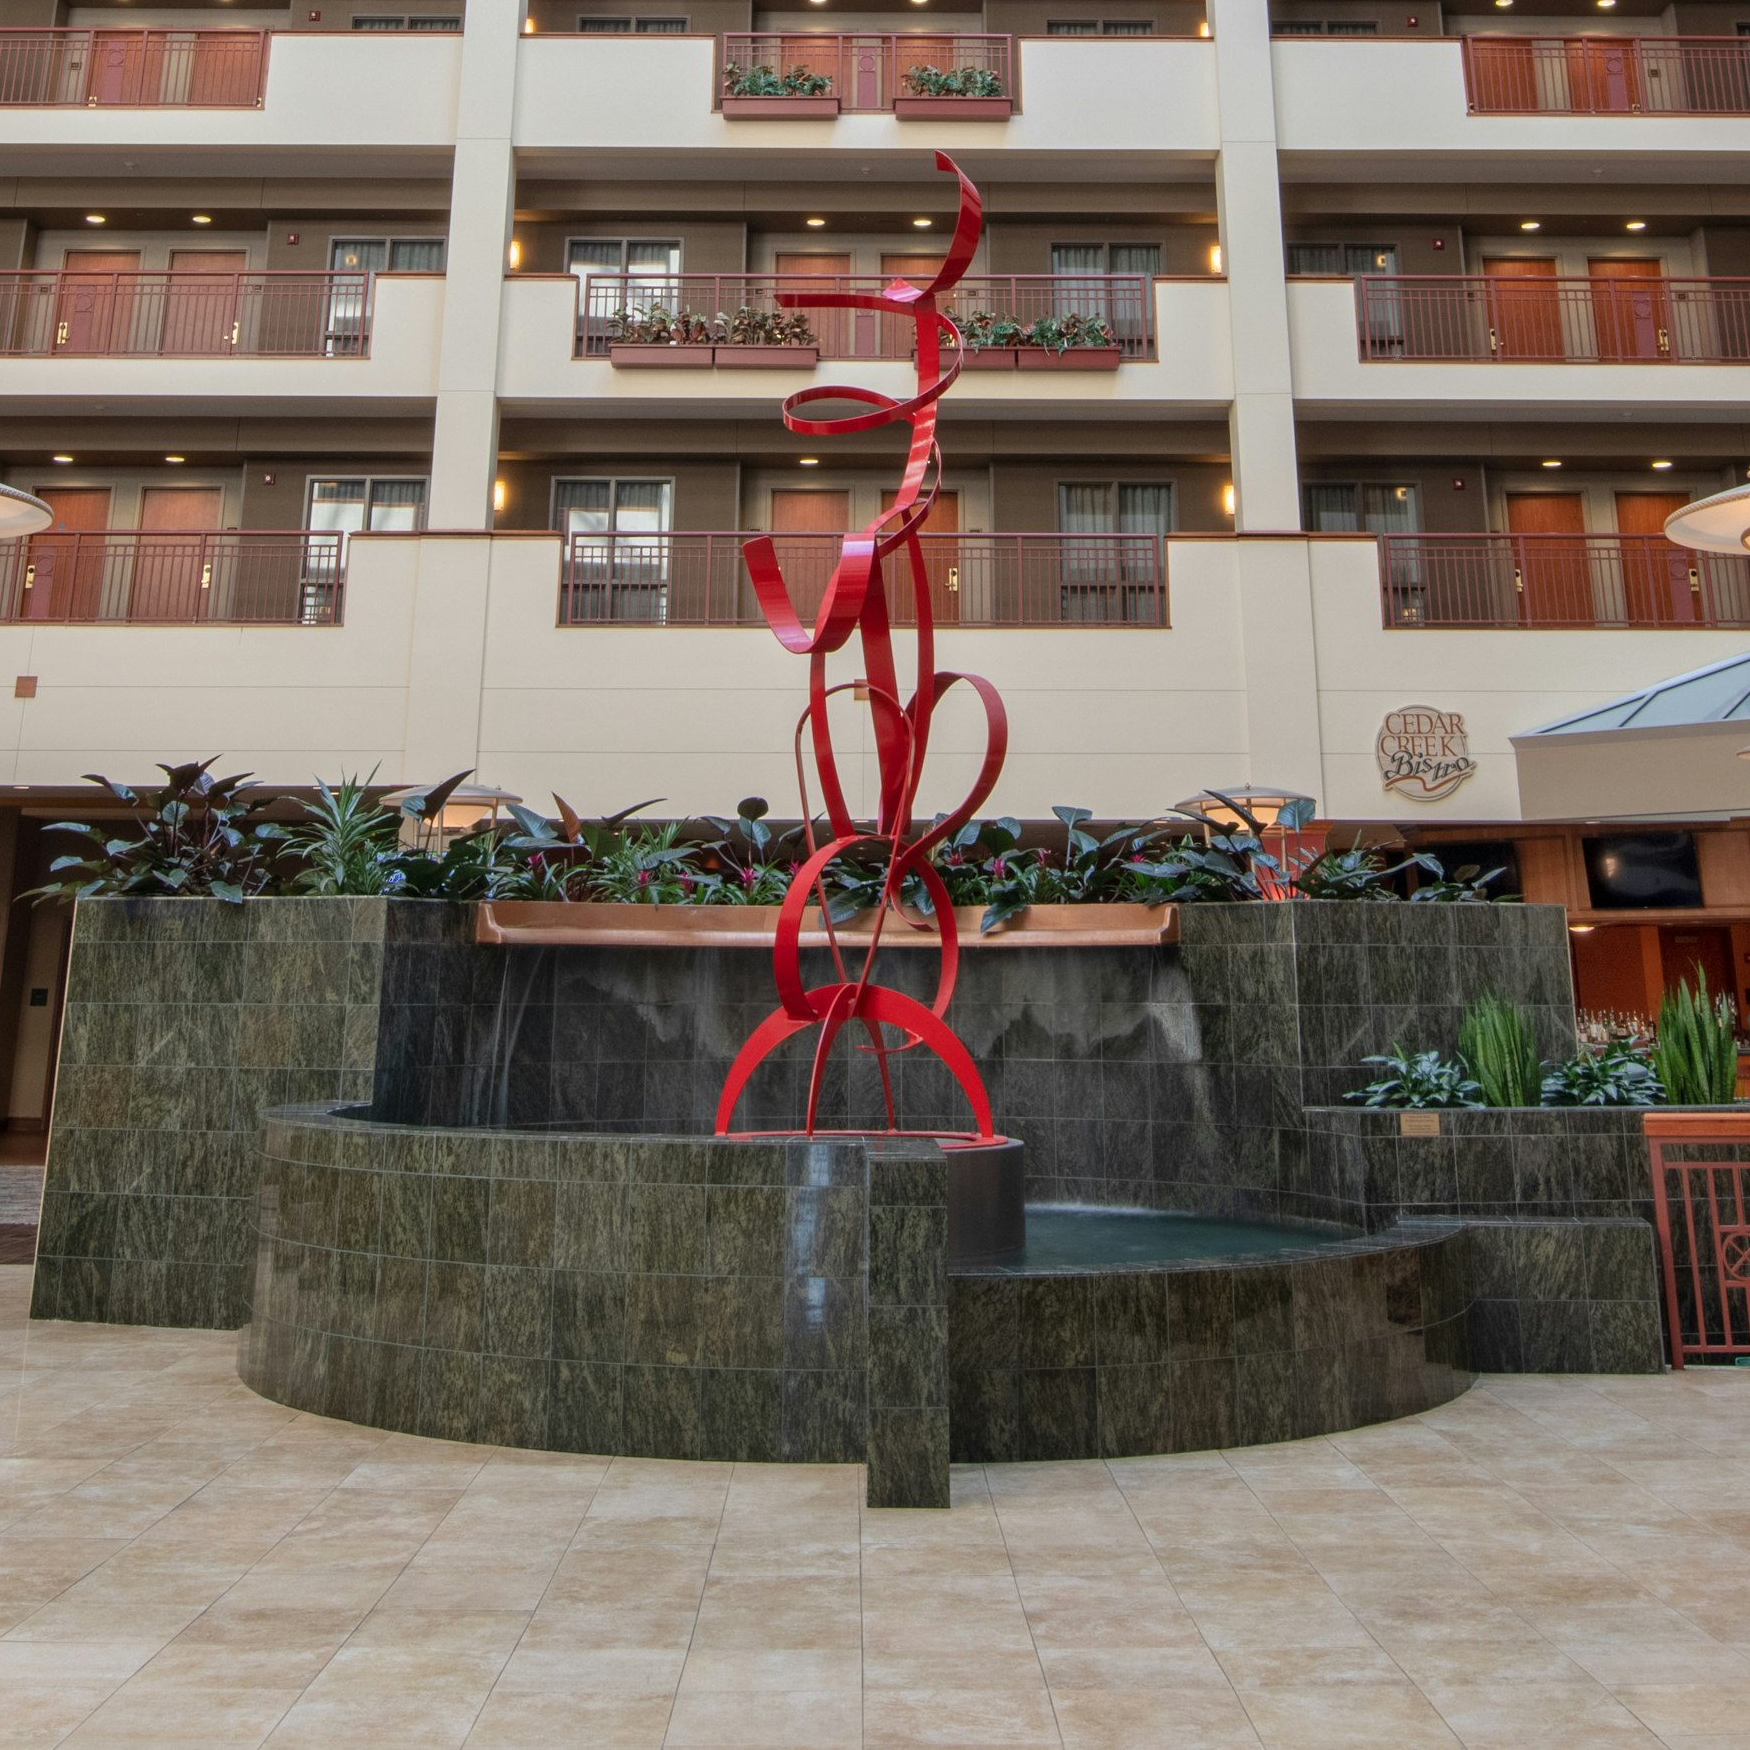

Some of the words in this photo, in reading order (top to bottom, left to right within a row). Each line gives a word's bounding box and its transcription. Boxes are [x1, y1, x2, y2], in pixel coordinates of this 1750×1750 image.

[1385, 713, 1465, 735] CEDAR
[1380, 735, 1459, 757] CREEK
[1383, 749, 1475, 782] Bistro
